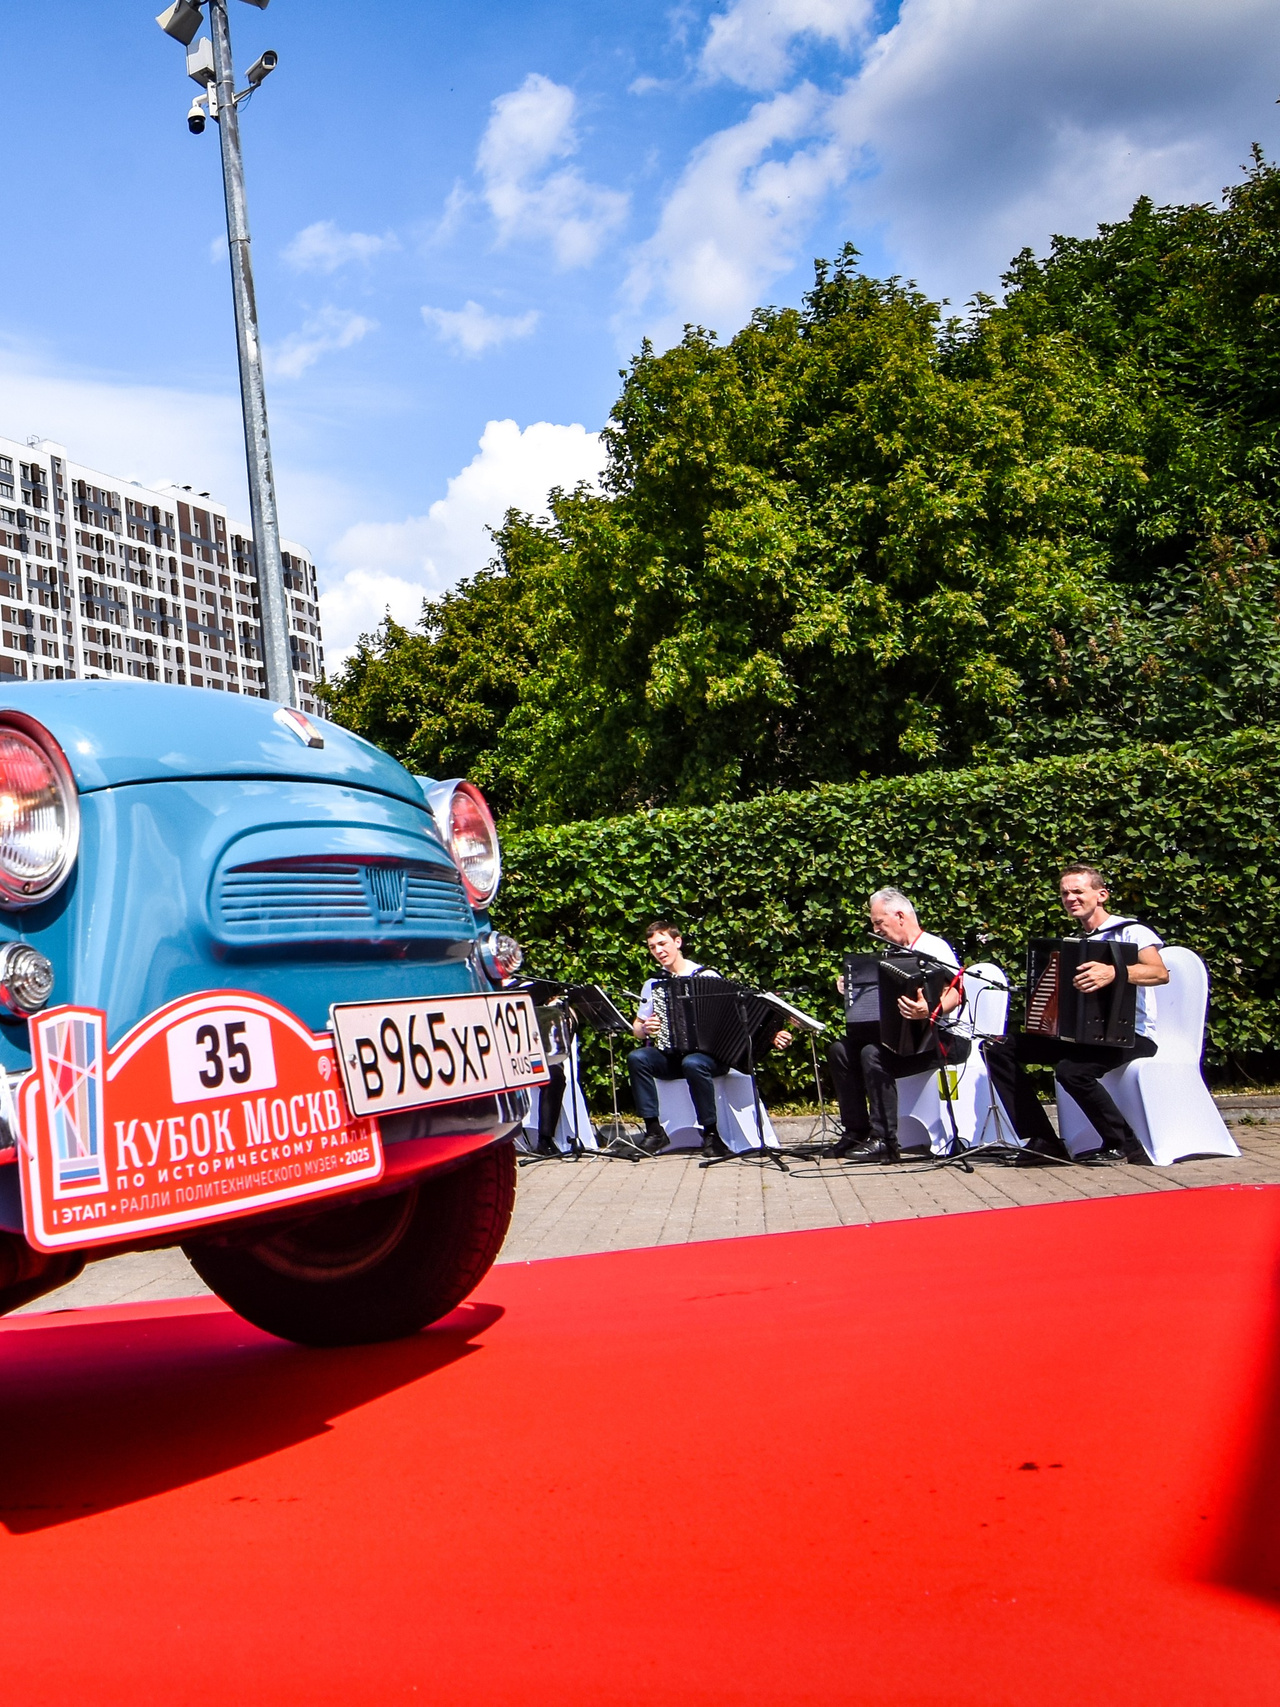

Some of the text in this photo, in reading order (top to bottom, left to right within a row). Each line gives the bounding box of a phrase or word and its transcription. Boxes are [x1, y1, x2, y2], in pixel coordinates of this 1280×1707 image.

[196, 1021, 252, 1089] 35
[355, 1001, 532, 1099] В965ХР 197
[511, 1056, 531, 1075] RUS
[114, 1108, 236, 1171] КУБОК
[117, 1128, 368, 1190] ПО ИСТОРИЧЕСКОМУ РАЛЛИ
[61, 1202, 107, 1224] ЭТАП
[120, 1191, 170, 1214] РАЛЛИ
[175, 1162, 302, 1204] ПОЛИТЕХНИЧЕСКОГО
[305, 1154, 339, 1176] МУЗЕЯ
[345, 1147, 371, 1166] 2025
